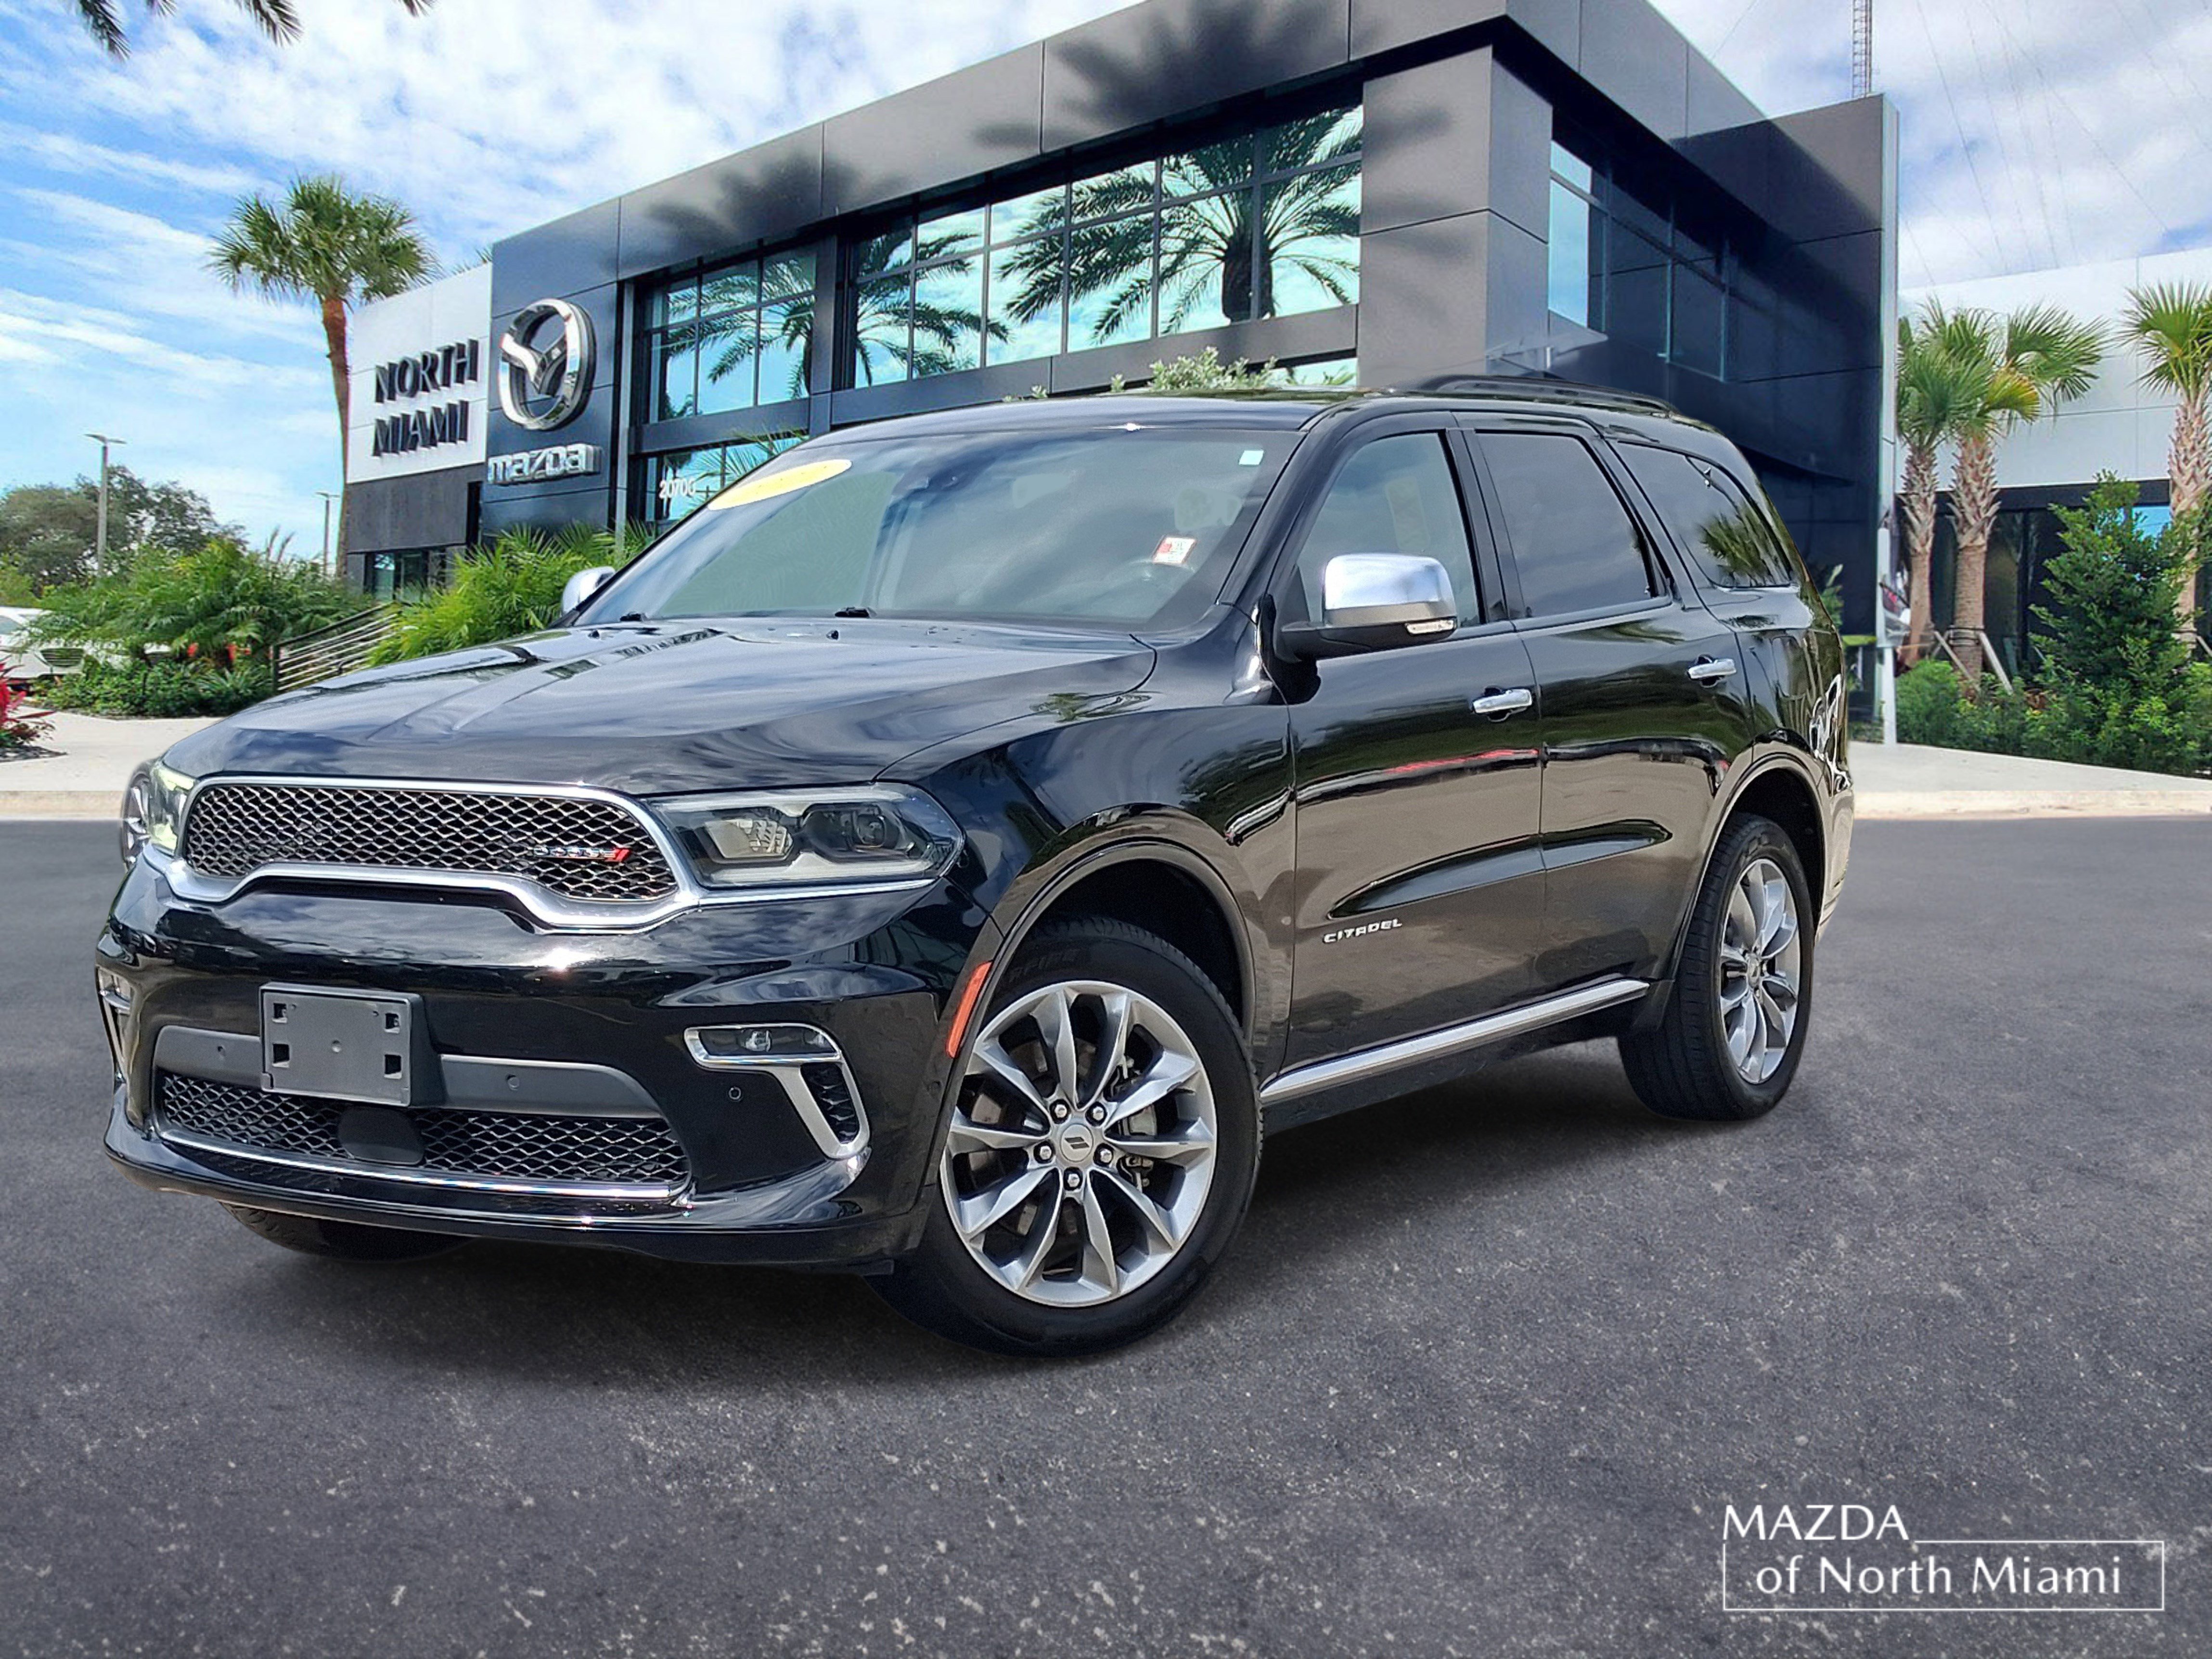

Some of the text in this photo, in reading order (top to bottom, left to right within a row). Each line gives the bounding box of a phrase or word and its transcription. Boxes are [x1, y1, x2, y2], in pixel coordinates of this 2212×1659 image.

[375, 338, 479, 403] NORTH
[373, 400, 469, 457] MIAMI
[488, 443, 599, 483] mazda
[1324, 918, 1402, 943] CITADEL
